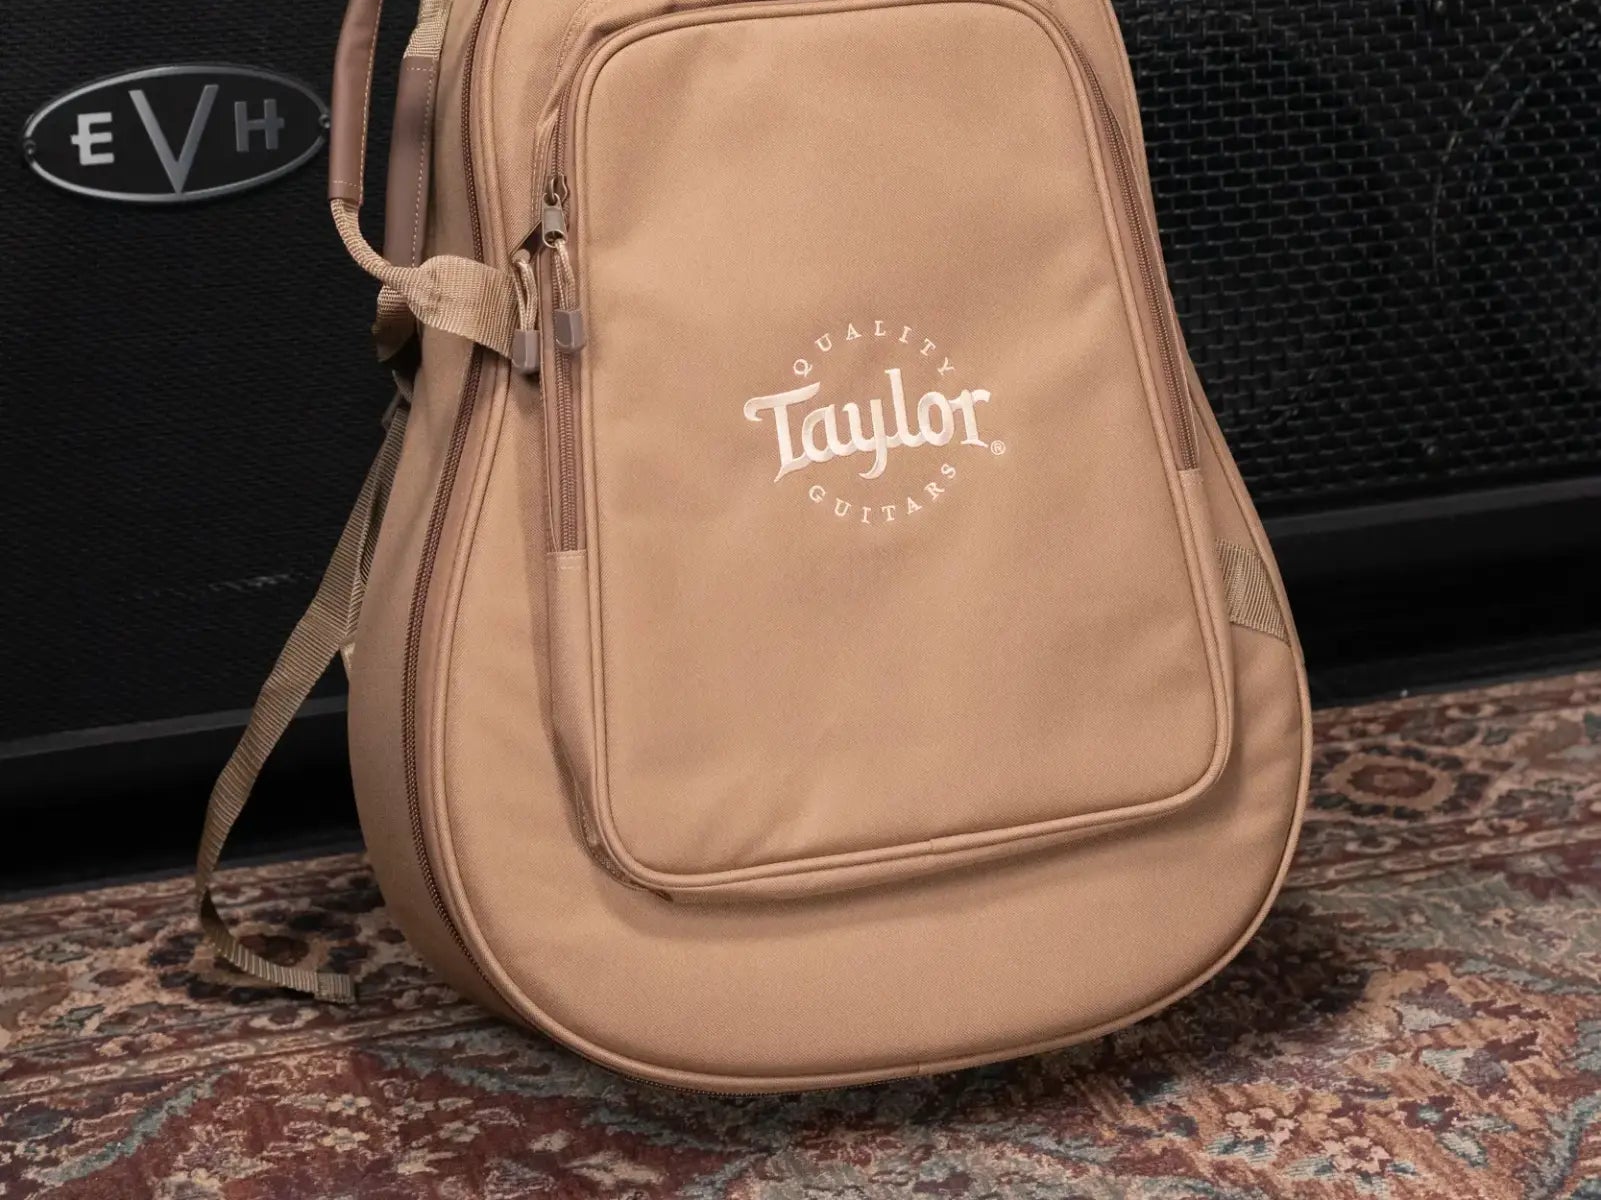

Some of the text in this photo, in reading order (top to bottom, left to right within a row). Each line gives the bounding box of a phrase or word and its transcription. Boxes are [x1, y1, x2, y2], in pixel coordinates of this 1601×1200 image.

[70, 83, 285, 195] EVH
[792, 319, 956, 378] QUALITY
[808, 463, 957, 525] GUITARS
